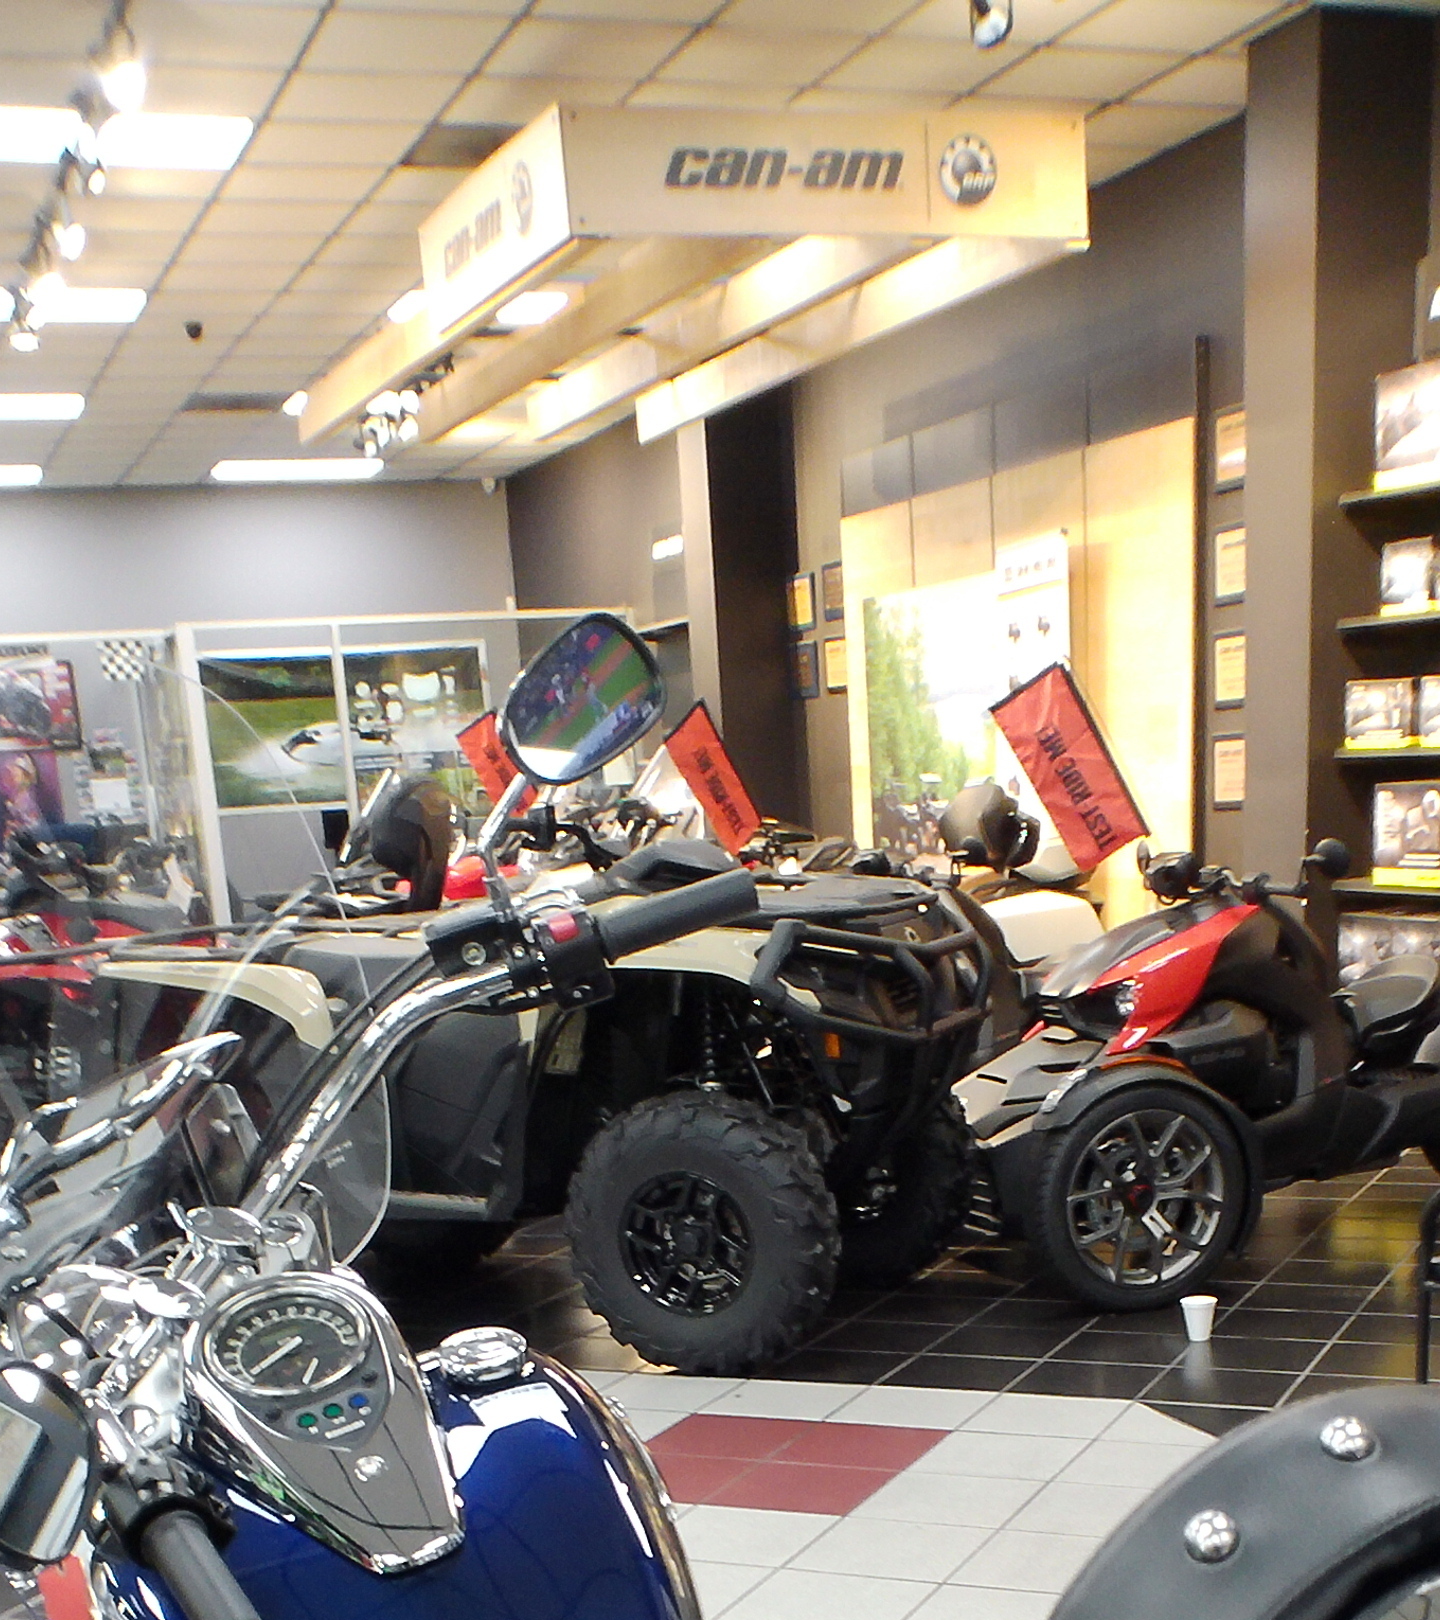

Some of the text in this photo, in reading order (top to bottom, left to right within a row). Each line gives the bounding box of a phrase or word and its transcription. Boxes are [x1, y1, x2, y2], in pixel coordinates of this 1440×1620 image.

[664, 147, 902, 189] can-am
[1055, 757, 1093, 806] RIDE
[1080, 805, 1118, 849] TEST
